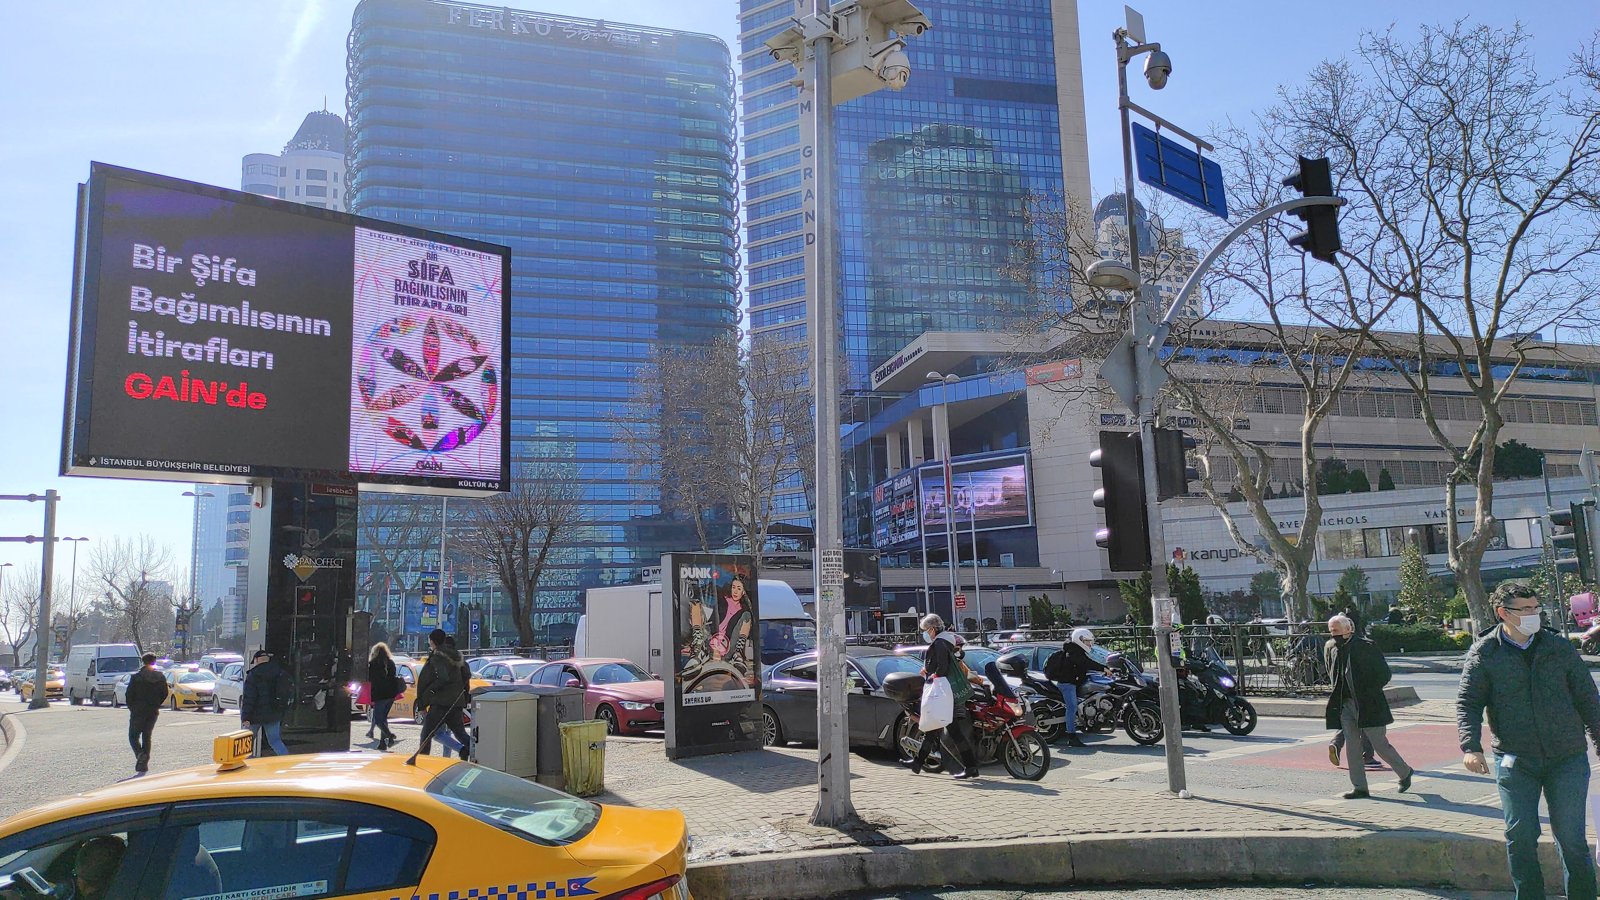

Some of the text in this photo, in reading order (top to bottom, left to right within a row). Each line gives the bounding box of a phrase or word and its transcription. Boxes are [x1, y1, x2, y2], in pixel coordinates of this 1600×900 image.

[448, 6, 552, 36] FERKO
[802, 145, 816, 246] GRAND
[132, 243, 256, 287] Bir Şifa
[426, 251, 438, 261] BİR
[394, 279, 467, 304] BAĞIMLISININ
[130, 285, 331, 337] Bağımlısının
[394, 294, 468, 317] İTİRAFLARI
[127, 319, 274, 370] İtirafları
[124, 369, 267, 410] GAİN'de
[100, 456, 250, 473] İSTANBUL BÜYÜKŞEHİR BELEDİYESİ
[458, 479, 487, 489] KÜLTÜR
[1424, 508, 1465, 518] VAKO
[680, 567, 712, 579] DUNK
[472, 624, 478, 632] P
[684, 696, 704, 705] SNEAKS
